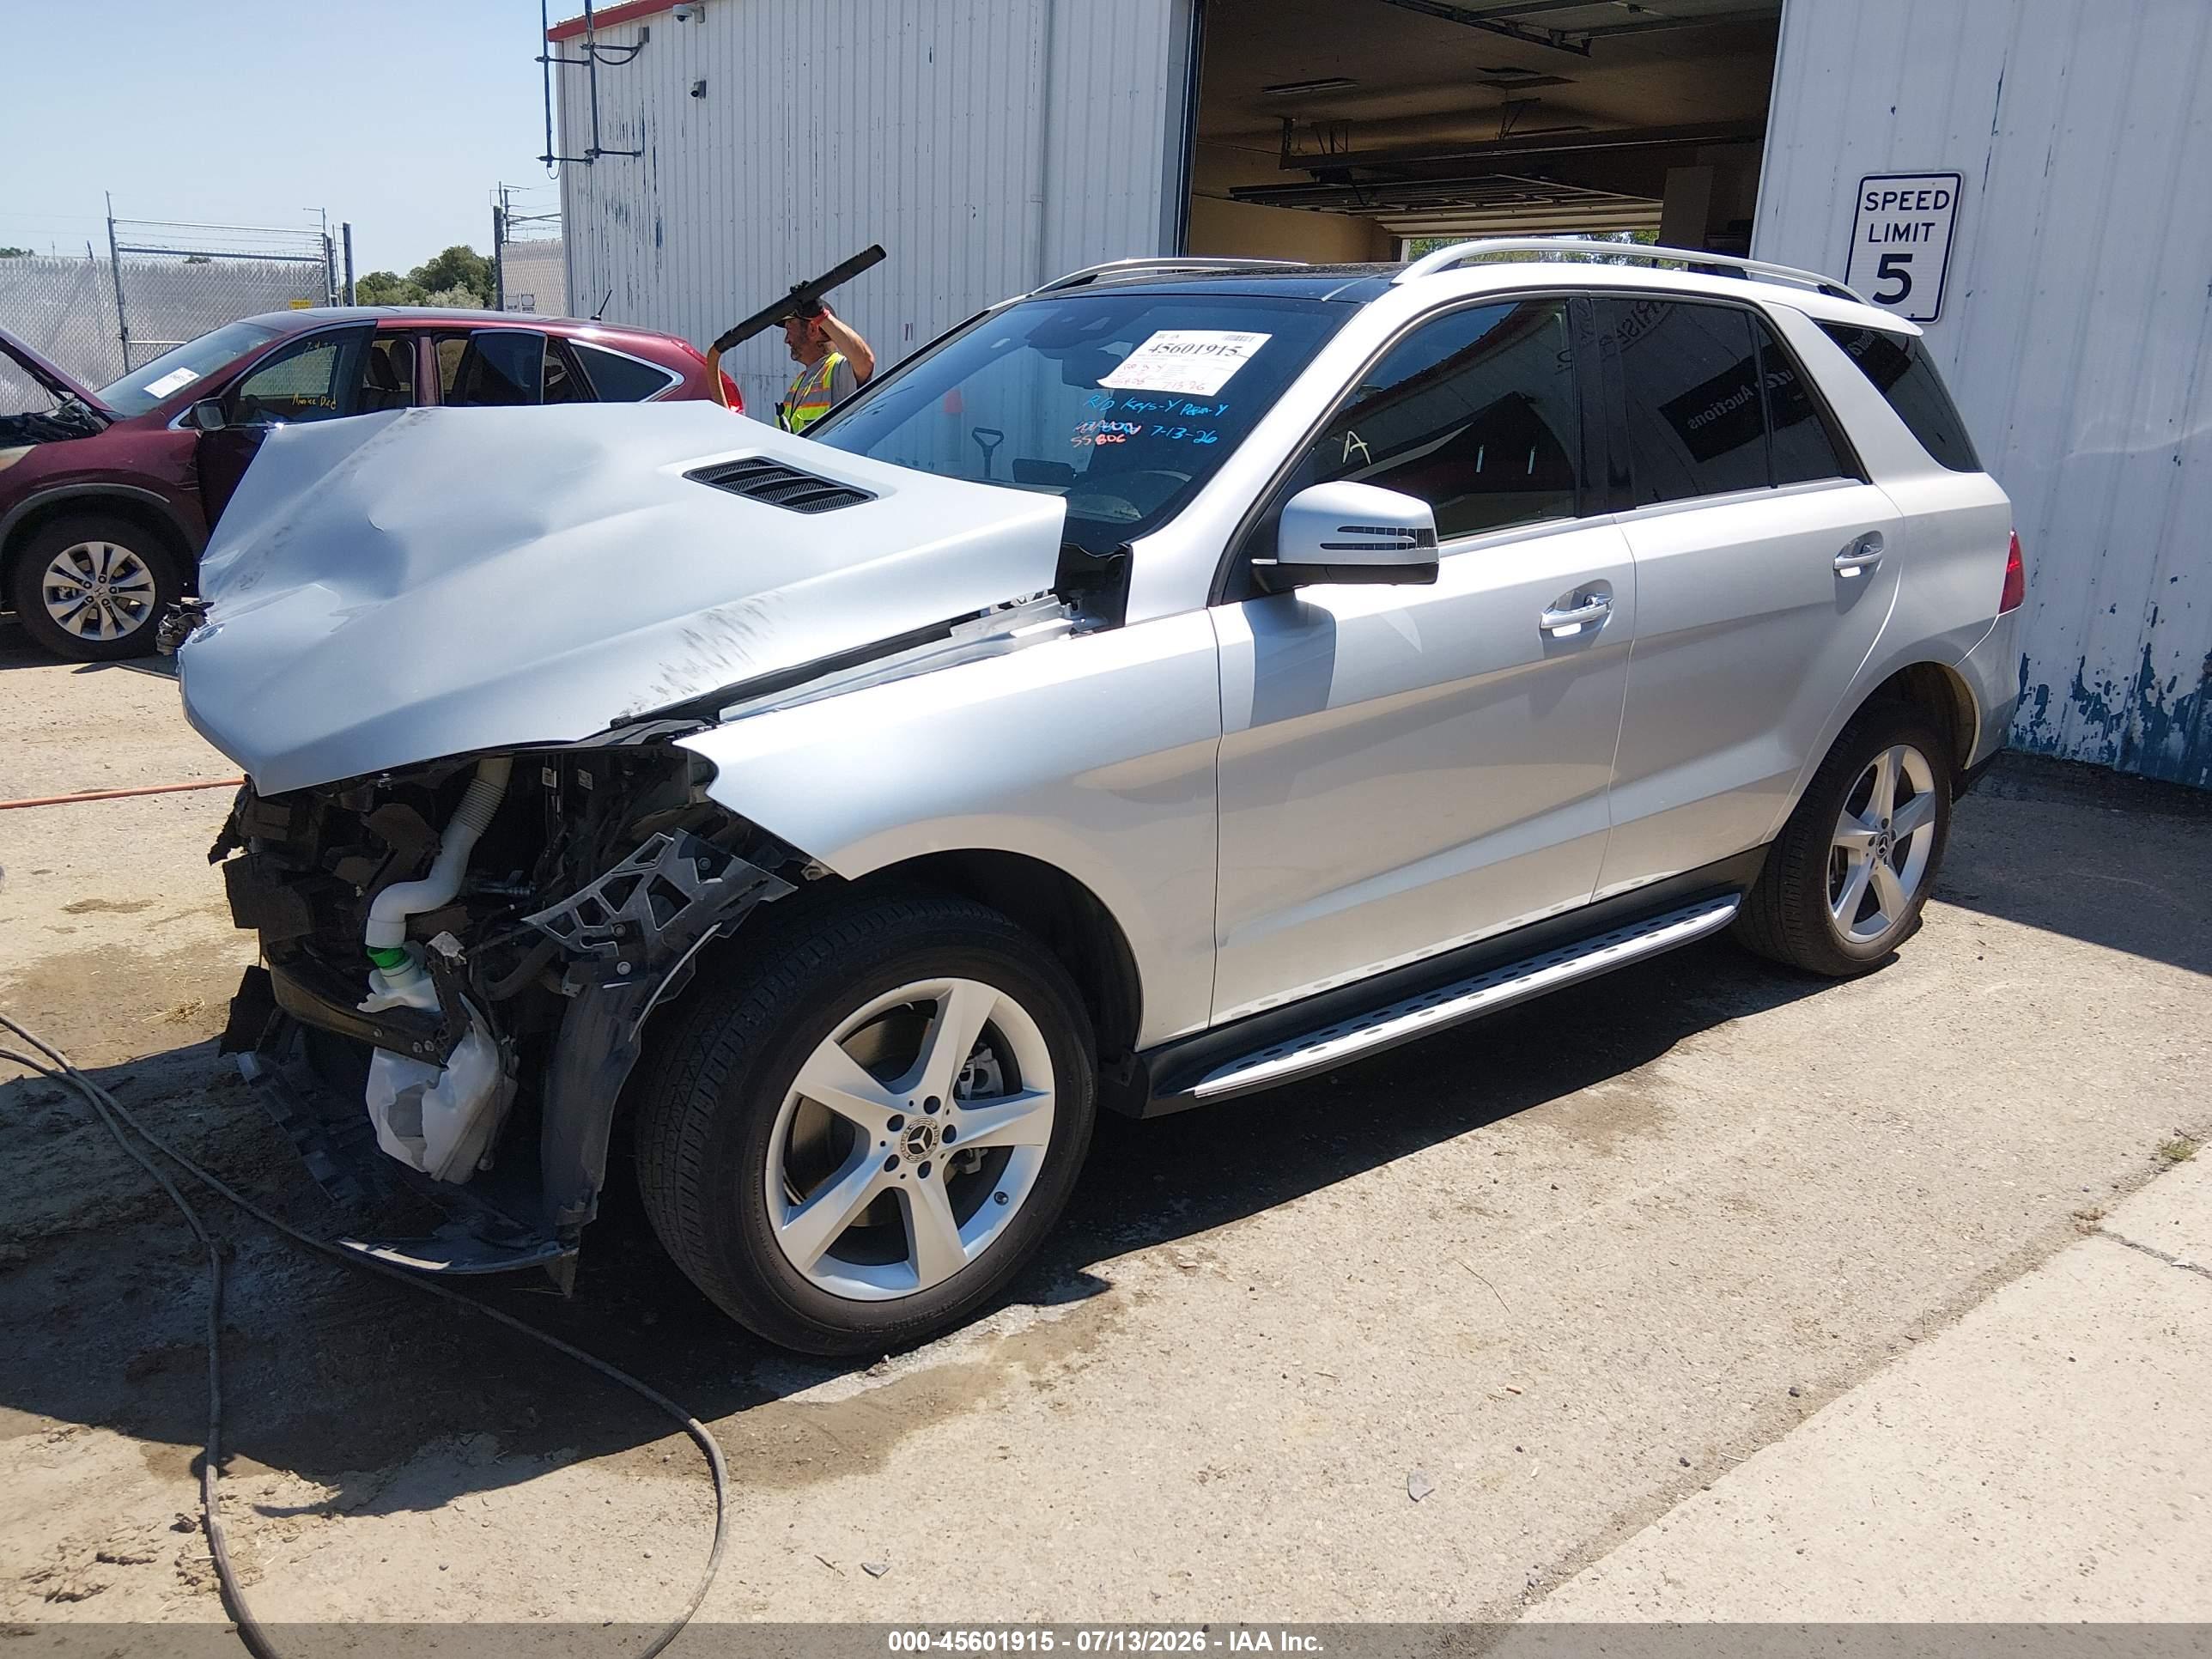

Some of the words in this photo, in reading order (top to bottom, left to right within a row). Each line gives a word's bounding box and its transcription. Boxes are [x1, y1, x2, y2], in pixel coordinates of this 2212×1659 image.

[1864, 190, 1950, 211] SPEED
[1869, 222, 1936, 243] LIMIT
[1872, 253, 1913, 305] 5
[1148, 343, 1243, 357] 45601915
[1121, 397, 1184, 414] Keys-Y
[1150, 424, 1218, 444] 7-13-26
[1342, 430, 1372, 465] A
